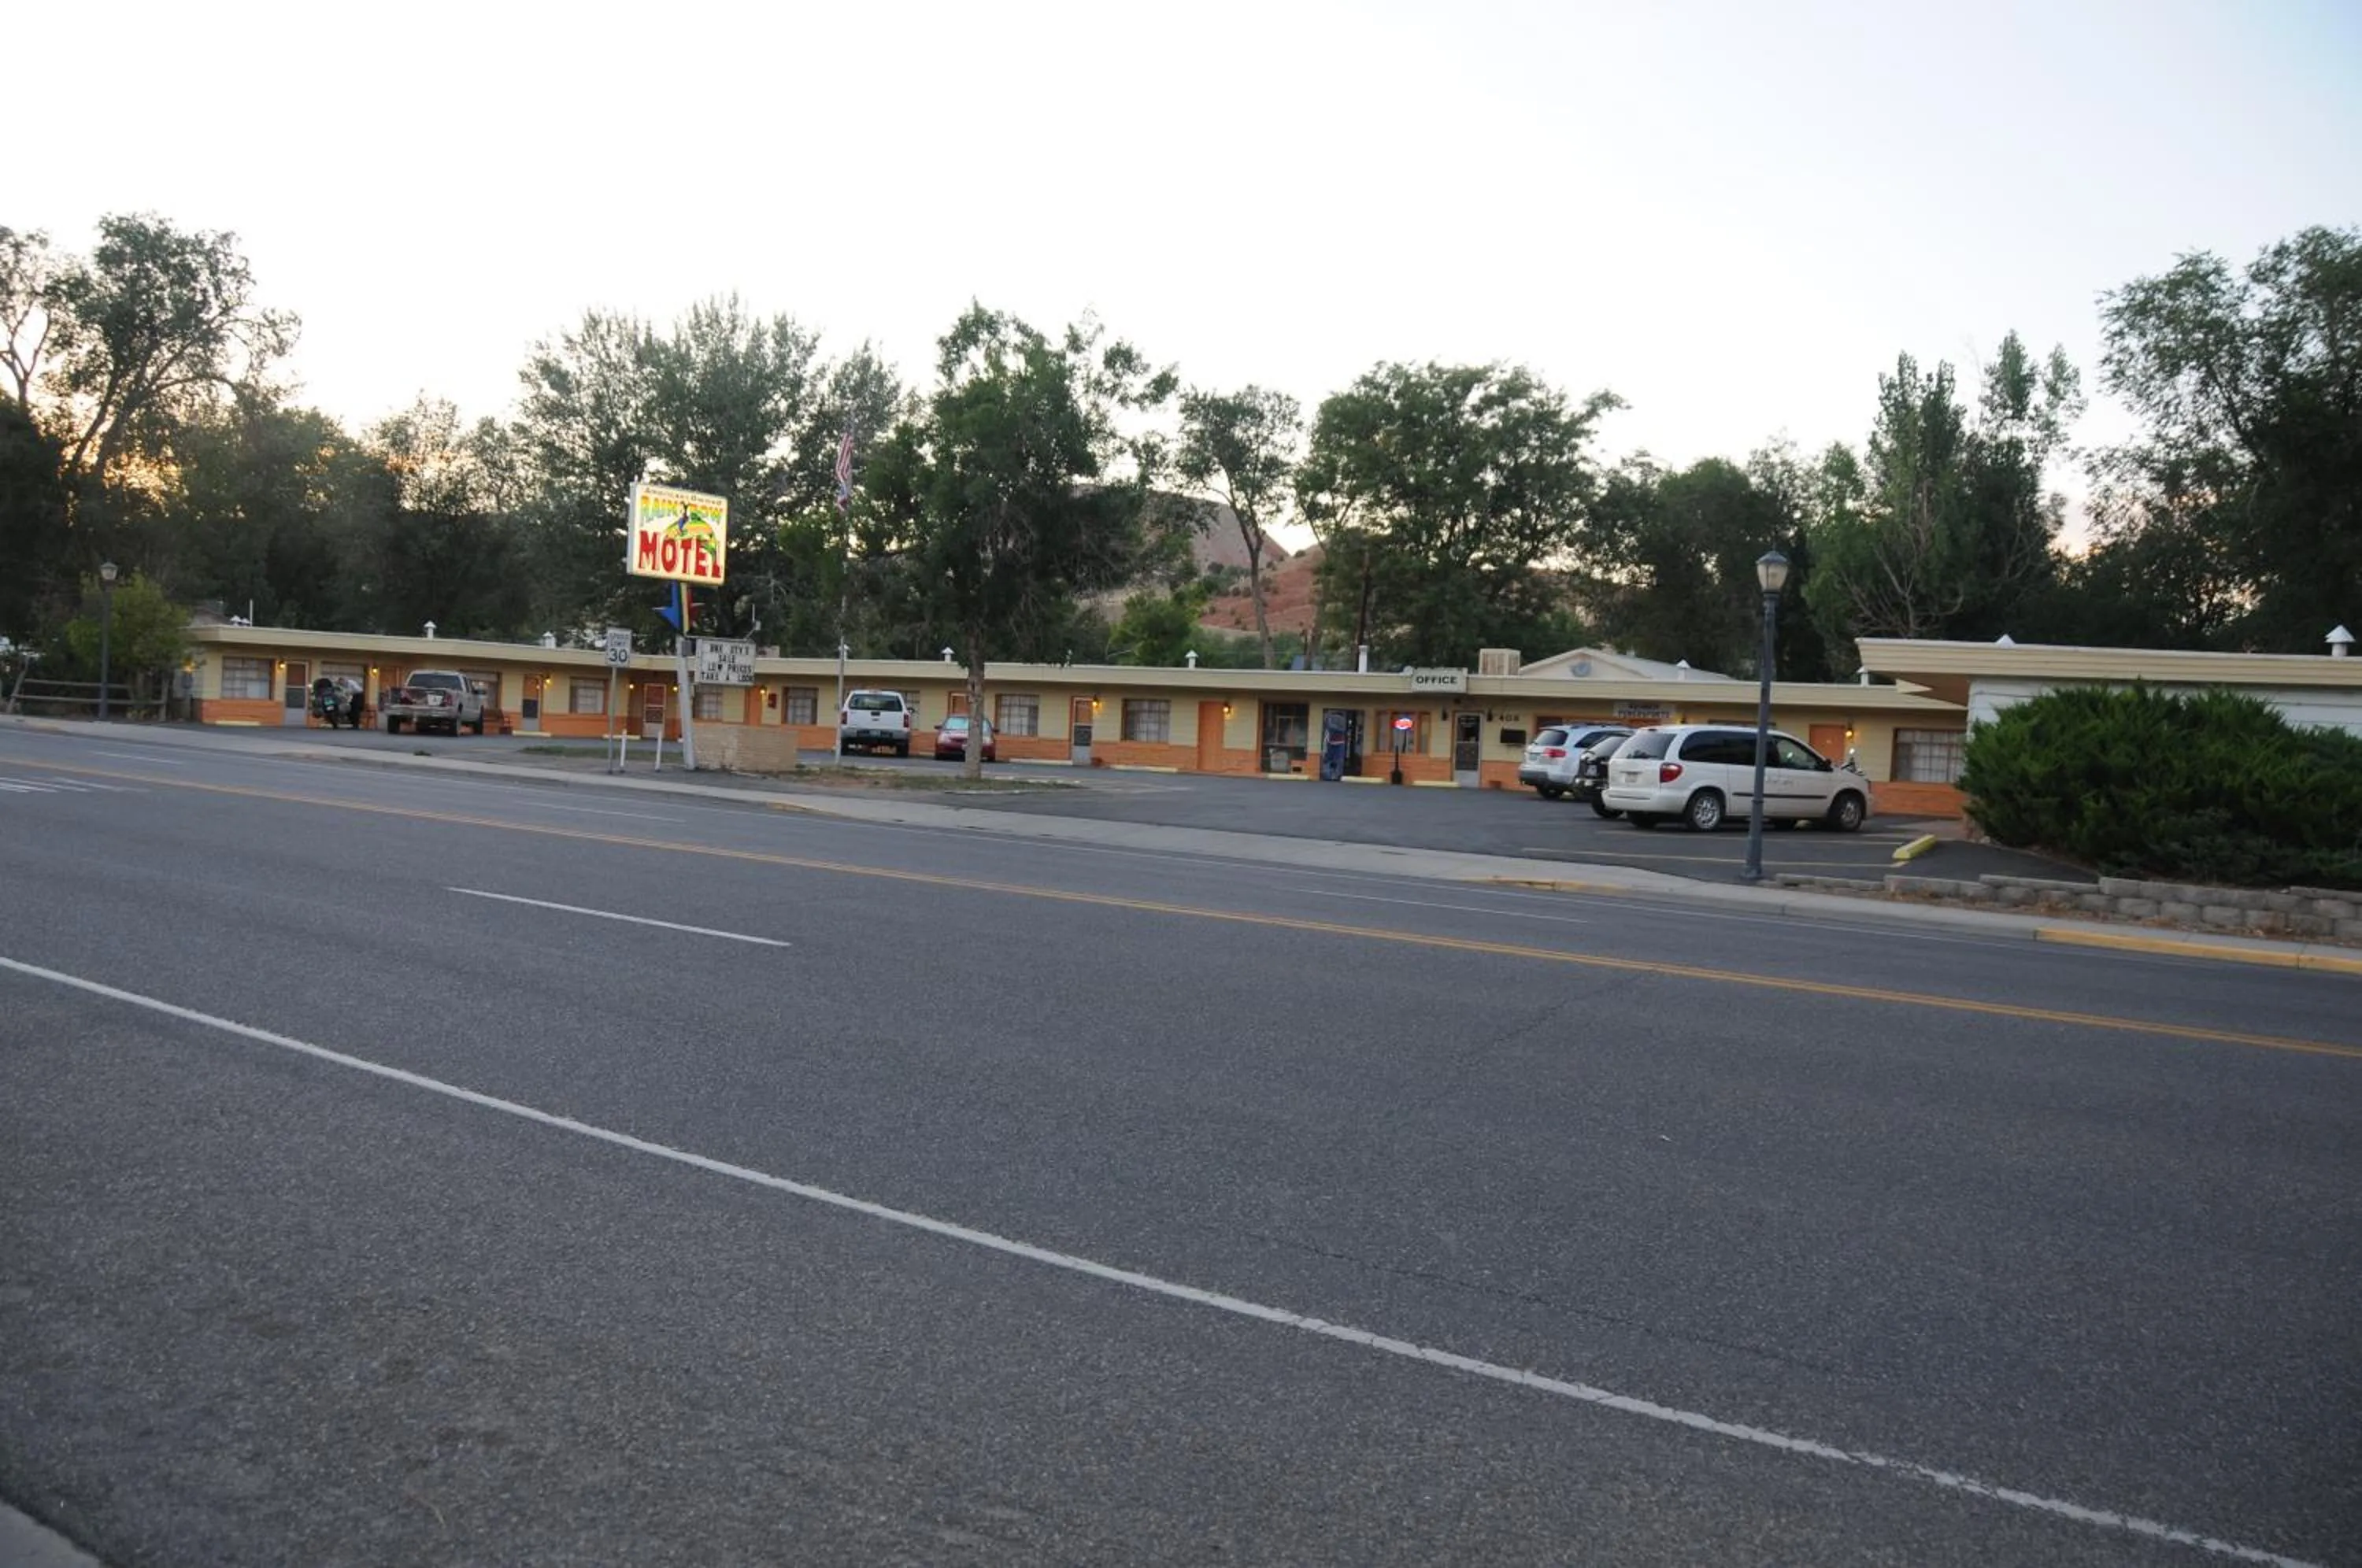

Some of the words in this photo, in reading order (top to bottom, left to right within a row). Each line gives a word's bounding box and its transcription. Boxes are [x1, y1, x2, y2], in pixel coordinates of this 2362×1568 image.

[639, 530, 721, 579] MOTEL
[609, 648, 628, 663] 30
[708, 662, 723, 671] LOW
[727, 664, 752, 674] PRICES
[701, 671, 719, 681] TAKE
[738, 674, 753, 682] LOOK
[1416, 675, 1457, 684] OFFICE
